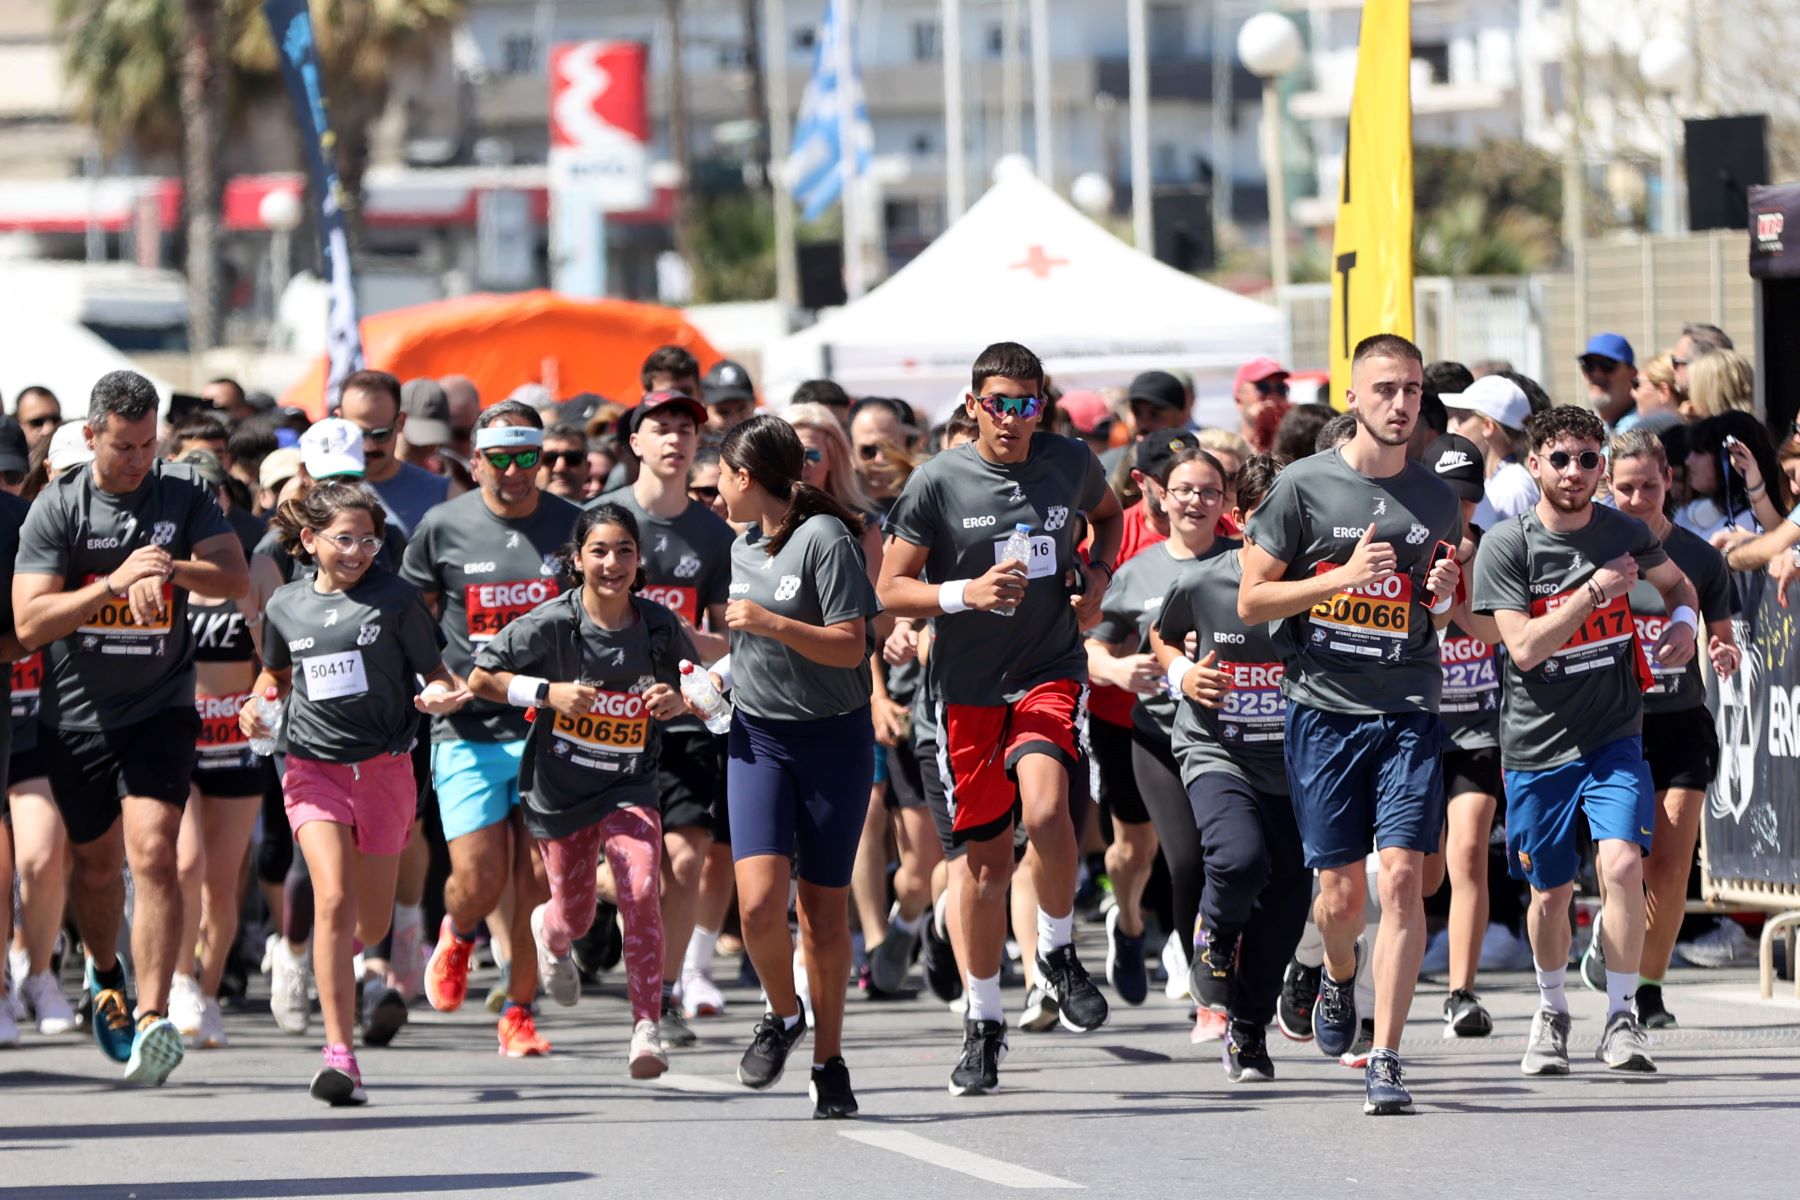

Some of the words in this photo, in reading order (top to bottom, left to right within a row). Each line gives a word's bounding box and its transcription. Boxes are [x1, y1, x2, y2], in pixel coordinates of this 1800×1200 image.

[1439, 450, 1468, 465] NIKE
[962, 515, 996, 528] ERGO
[1333, 526, 1365, 538] ERGO
[86, 537, 119, 549] ERGO
[463, 561, 496, 574] ERGO
[480, 581, 546, 608] ERGO
[1529, 583, 1559, 595] ERGO
[85, 604, 169, 627] 004
[187, 612, 243, 648] IKE
[1566, 610, 1626, 645] 117
[288, 637, 315, 652] ERGO
[1213, 631, 1245, 644] ERGO
[311, 659, 354, 679] 50417
[589, 692, 642, 718] RGO
[559, 714, 643, 744] 50655
